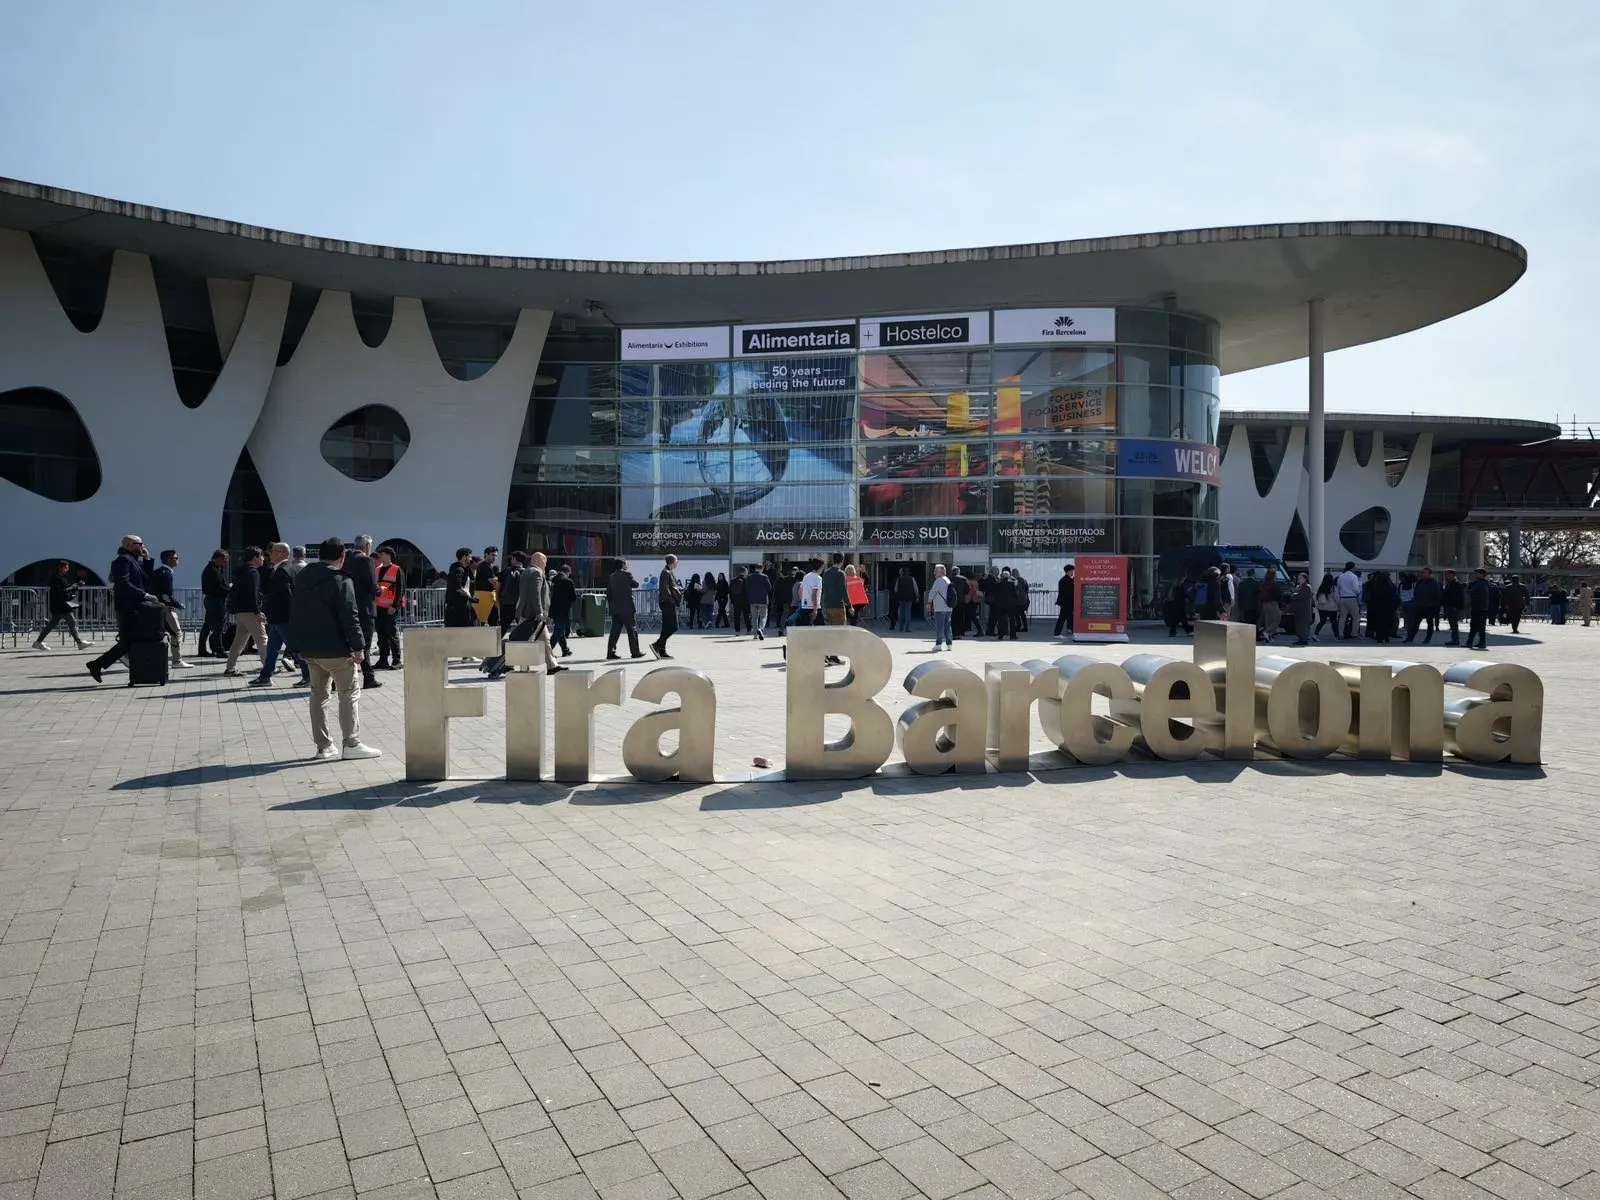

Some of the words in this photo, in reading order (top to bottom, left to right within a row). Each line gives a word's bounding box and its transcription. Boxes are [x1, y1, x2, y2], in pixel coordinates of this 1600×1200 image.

[748, 330, 851, 349] Alimentaria
[886, 324, 963, 342] Hostelco
[1041, 328, 1054, 336] Fira
[1055, 328, 1087, 336] Barcelona
[627, 341, 664, 350] Alimentaria
[674, 340, 709, 348] Exhibitions
[771, 366, 788, 377] 50
[791, 367, 822, 378] years
[792, 378, 809, 388] the
[812, 376, 846, 388] future
[1047, 391, 1084, 405] FOCUS
[1086, 387, 1102, 397] ON
[1051, 407, 1102, 423] BUSINESS
[632, 532, 684, 540] EXPOSITORES
[684, 532, 691, 540] Y
[691, 532, 721, 540] PRENSA
[756, 528, 795, 540] Accés
[809, 528, 854, 540] Acceso
[870, 528, 915, 540] Access
[918, 527, 949, 540] SUD
[998, 528, 1046, 537] VISITANTES
[1047, 528, 1105, 537] ACREDITADOS
[635, 539, 676, 547] EXHIBITORS
[677, 539, 694, 547] AND
[695, 539, 718, 547] PRESS
[1008, 536, 1058, 544] REGISTERED
[1059, 536, 1096, 544] VISITORS
[403, 626, 716, 783] Fira
[786, 620, 1544, 781] Barcelona
